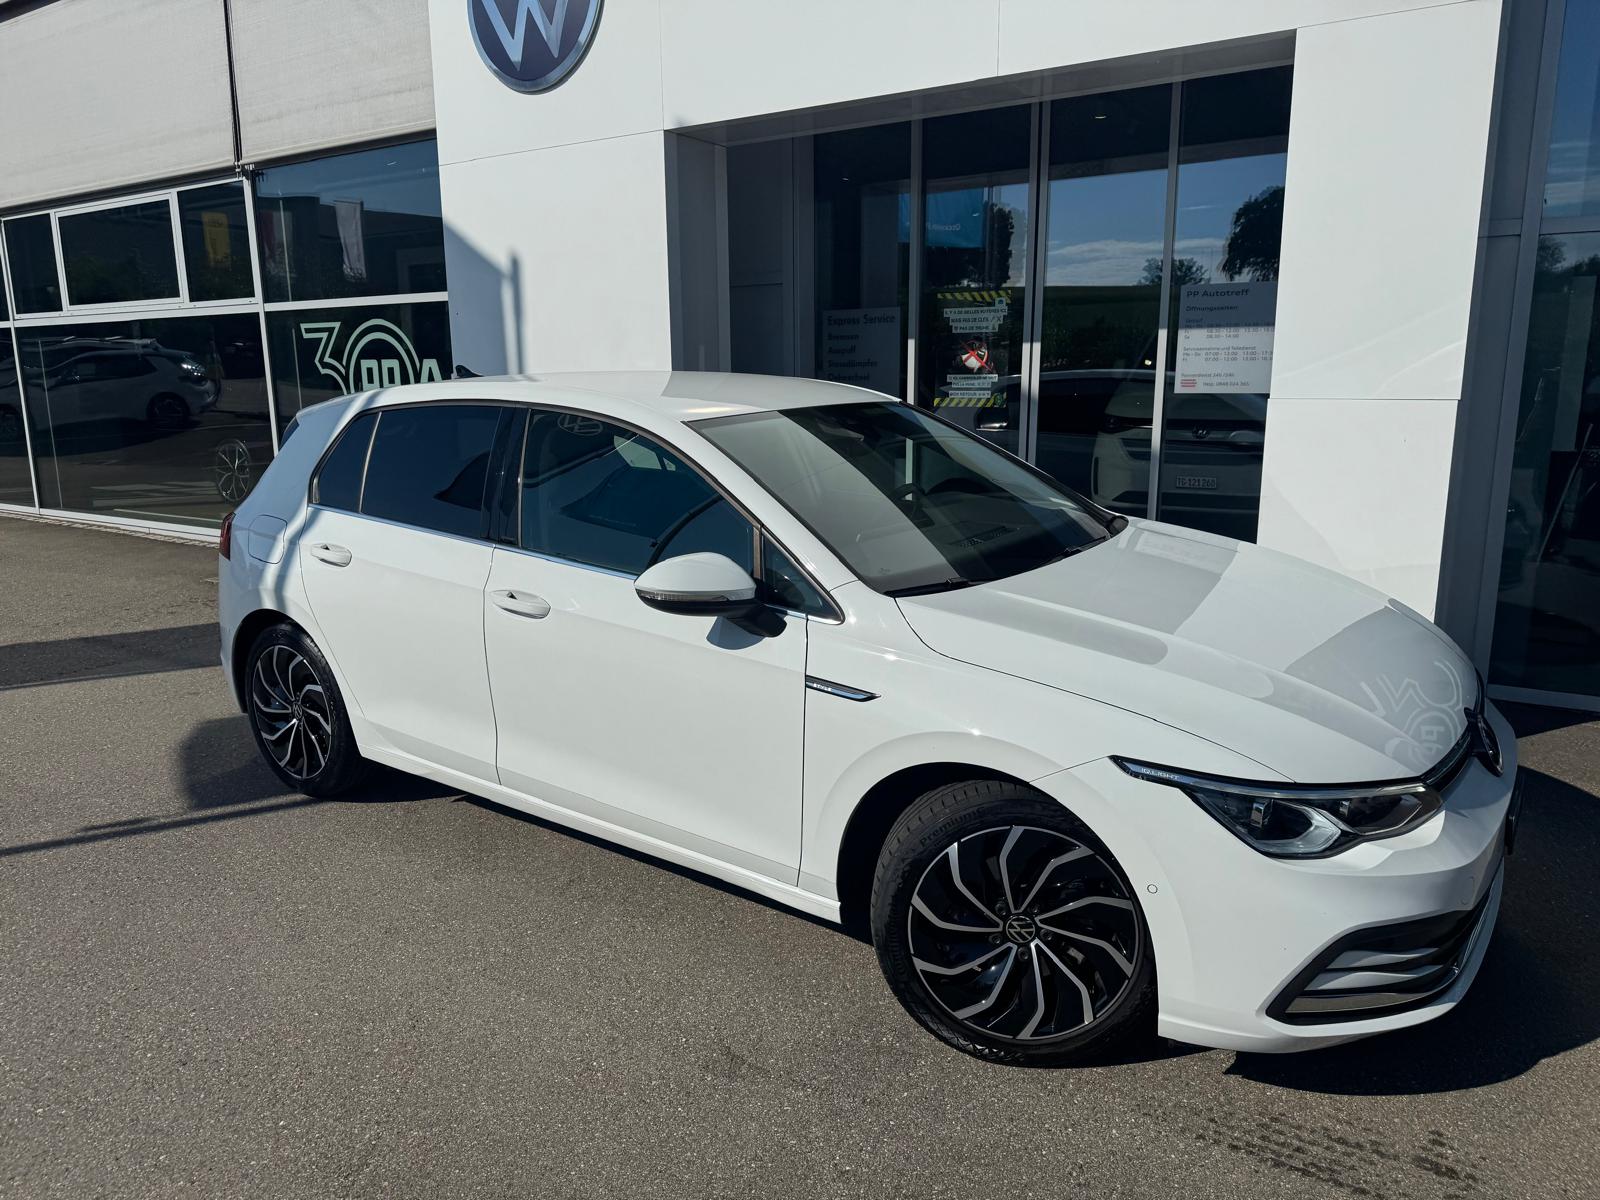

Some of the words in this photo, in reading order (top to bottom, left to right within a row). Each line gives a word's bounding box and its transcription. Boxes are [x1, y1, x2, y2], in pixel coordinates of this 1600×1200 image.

[1186, 290, 1200, 298] PP
[1201, 288, 1250, 297] Autotreff
[827, 315, 861, 327] Express
[863, 312, 896, 324] Service
